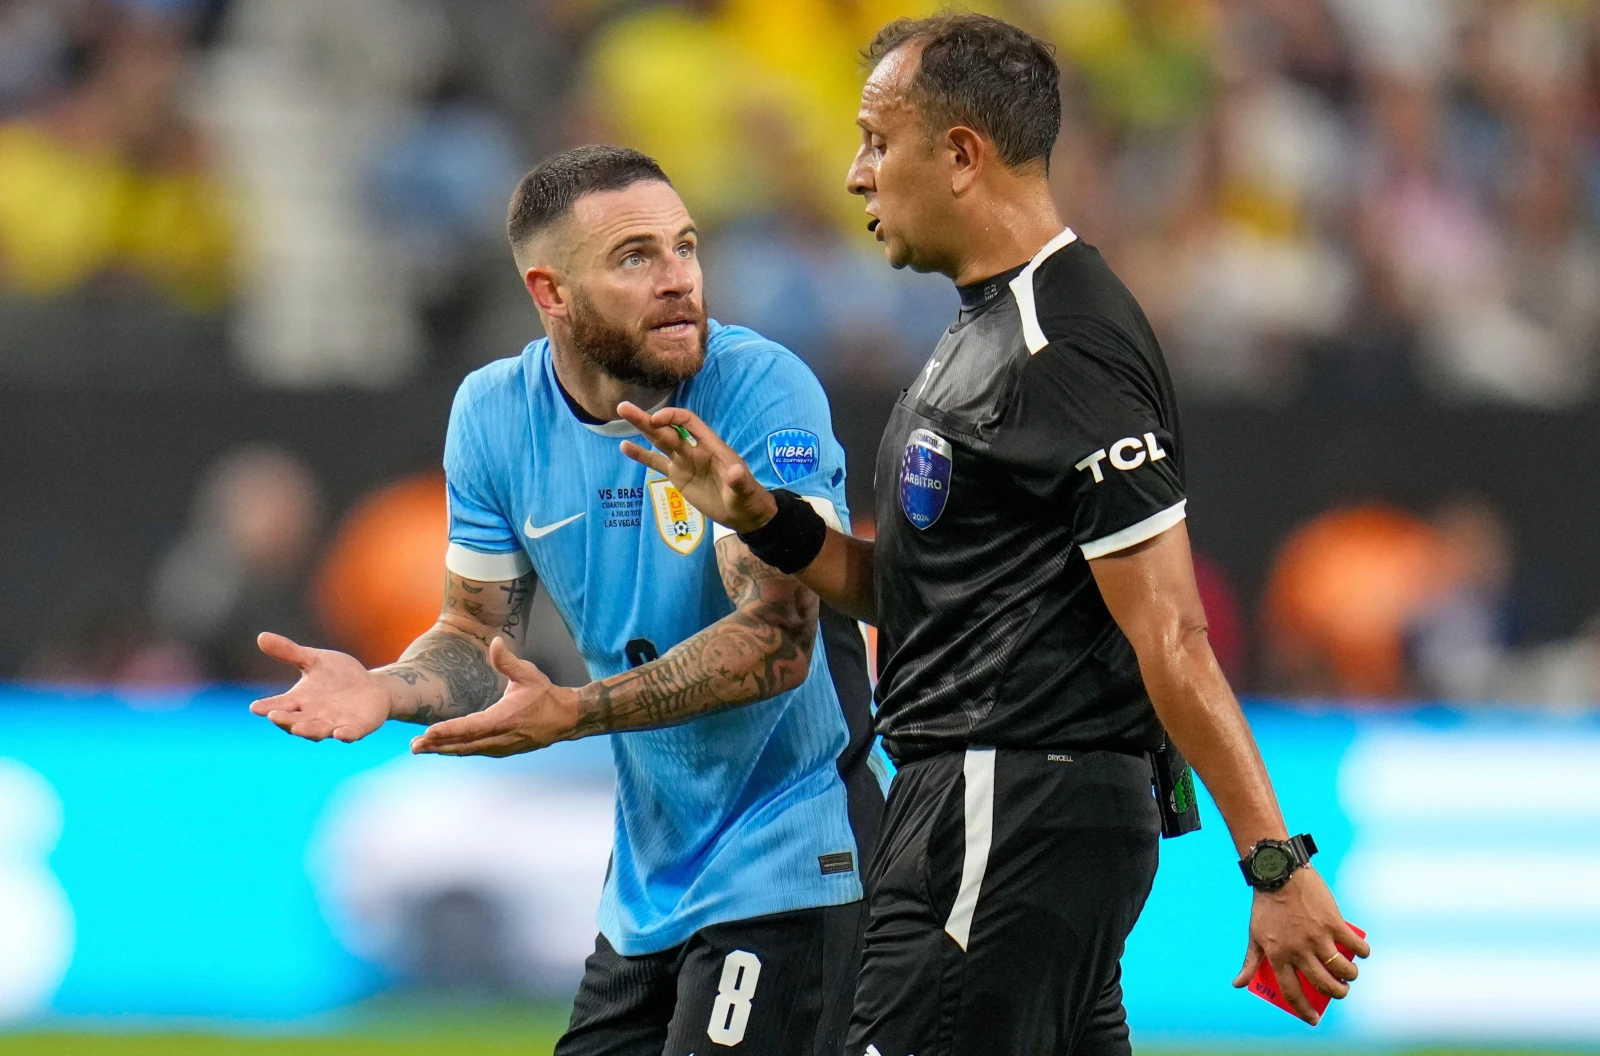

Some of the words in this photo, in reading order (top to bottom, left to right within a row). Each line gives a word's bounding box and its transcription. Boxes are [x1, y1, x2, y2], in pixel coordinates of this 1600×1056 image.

[775, 446, 813, 458] VIBRA
[1075, 432, 1166, 483] TCL
[598, 489, 615, 500] VS.
[669, 491, 683, 518] AUF
[618, 519, 640, 527] VEGAS
[913, 513, 929, 522] 2024
[1047, 754, 1074, 762] DRYCELL
[1256, 982, 1277, 999] FIFA
[707, 949, 762, 1047] 8
